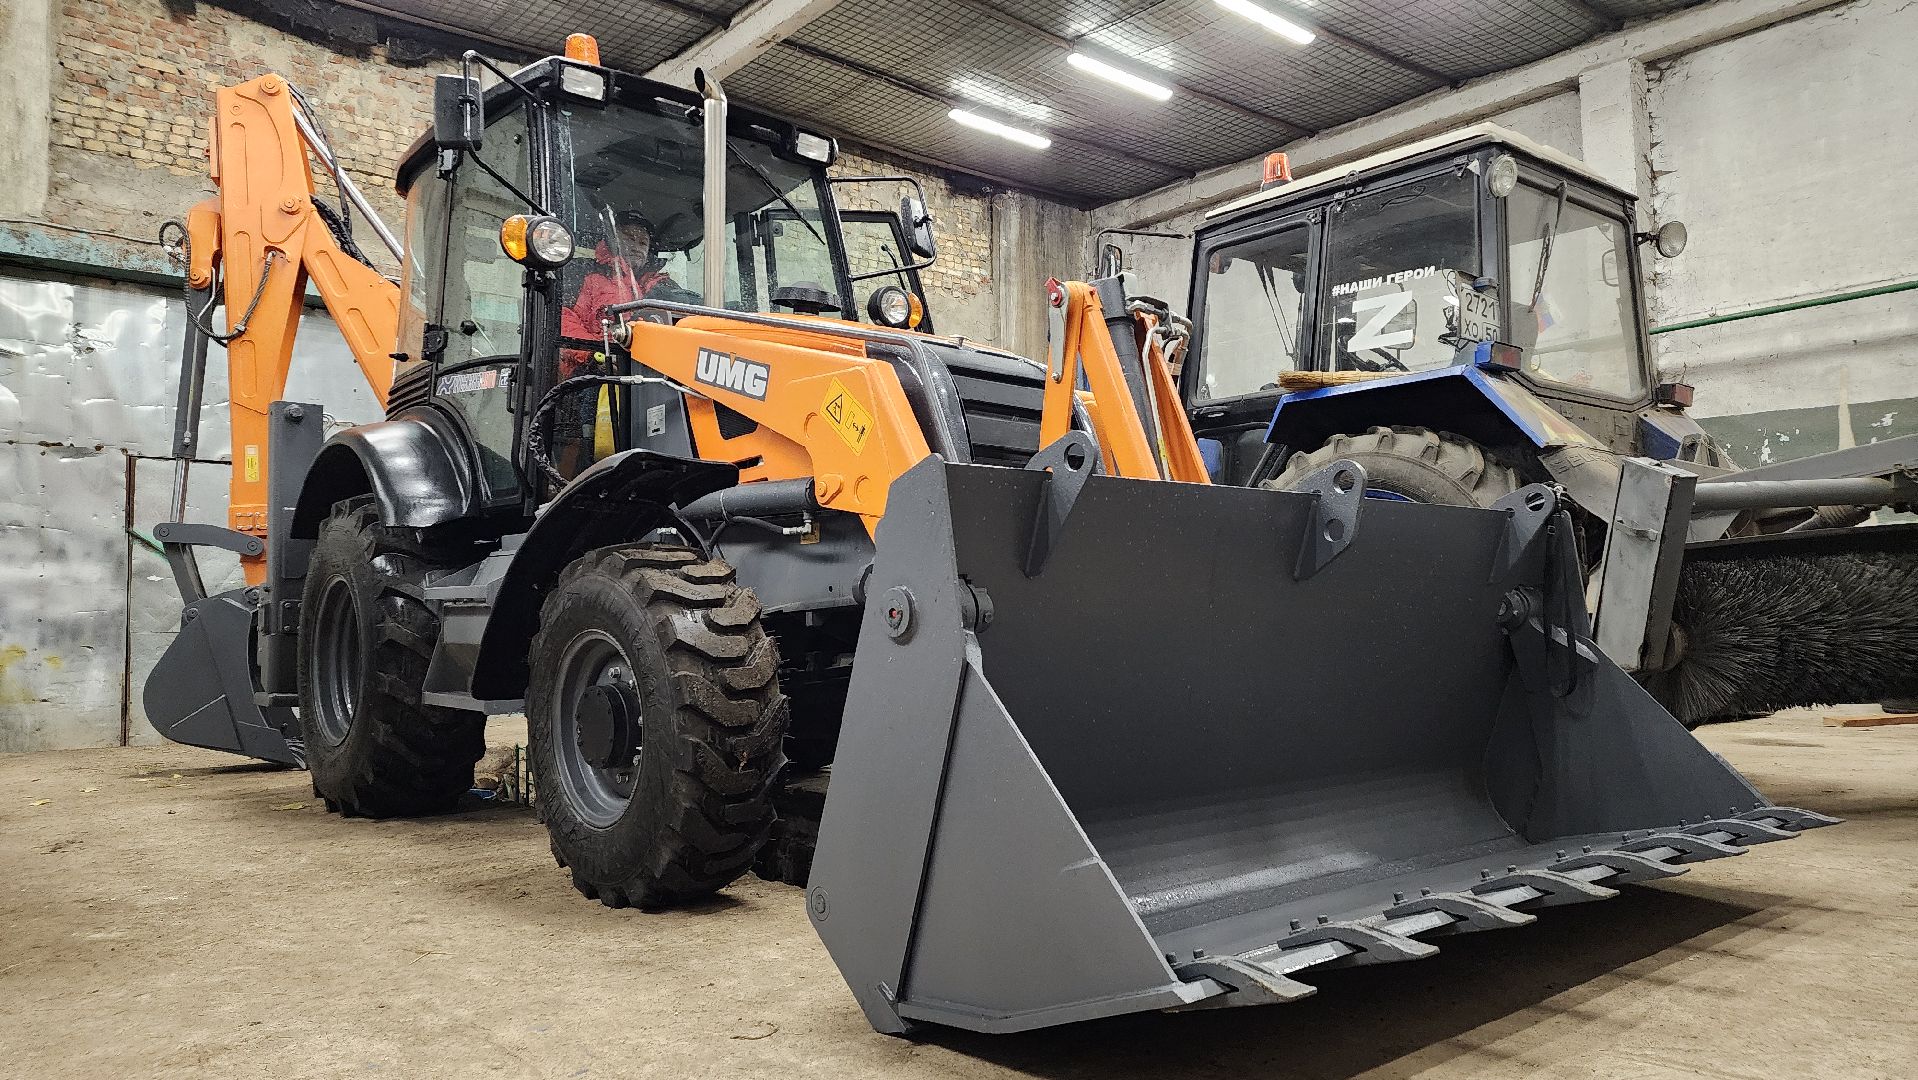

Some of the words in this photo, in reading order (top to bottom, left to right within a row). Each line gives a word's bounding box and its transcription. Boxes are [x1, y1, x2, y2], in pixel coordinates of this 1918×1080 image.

[1332, 276, 1383, 297] #НАШИ
[1386, 265, 1436, 286] ГЕРОИ
[1347, 290, 1414, 352] Z
[1465, 292, 1496, 321] 2721
[697, 351, 768, 397] UMG
